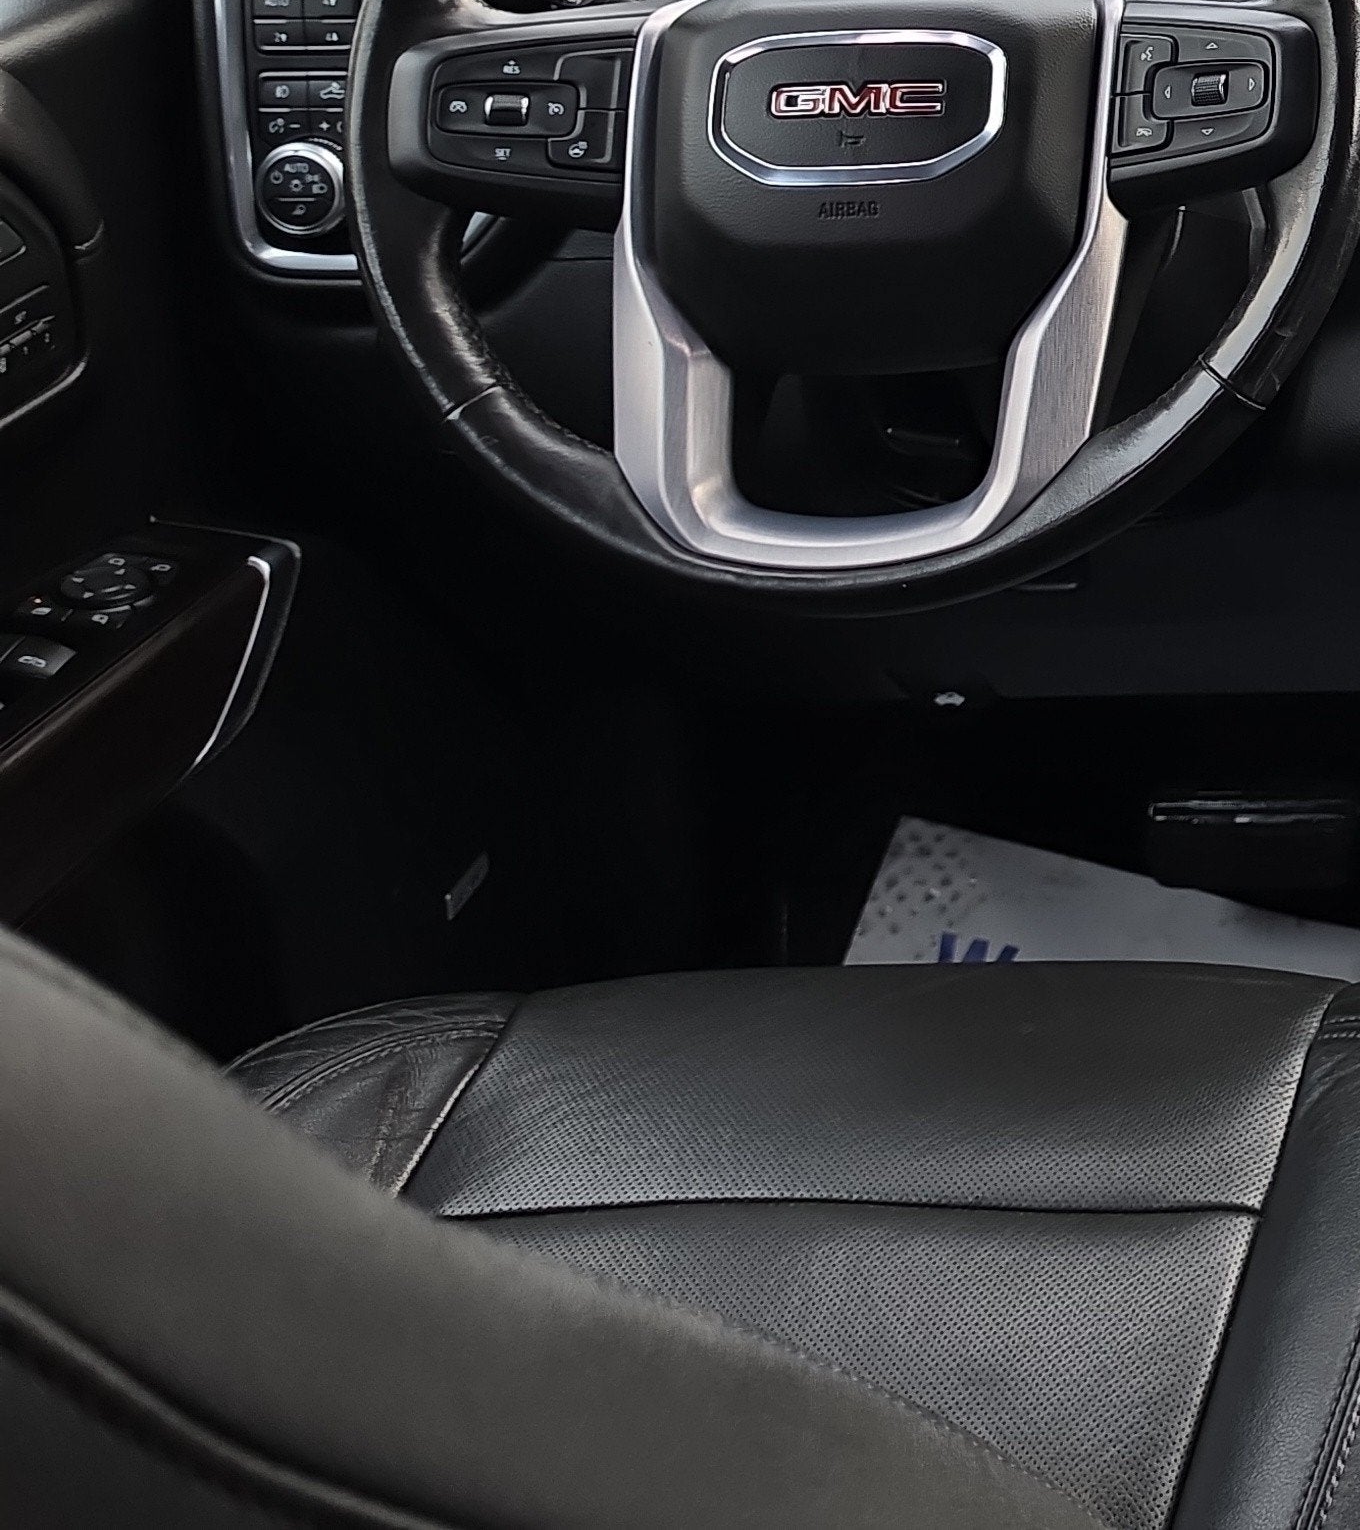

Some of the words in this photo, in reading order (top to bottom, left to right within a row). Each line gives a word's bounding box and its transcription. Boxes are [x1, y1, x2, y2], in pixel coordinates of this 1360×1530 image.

[502, 64, 521, 74] RES
[770, 81, 945, 118] GMC
[494, 148, 511, 157] SET
[284, 162, 309, 173] AUTO
[818, 201, 880, 220] AIRBAG
